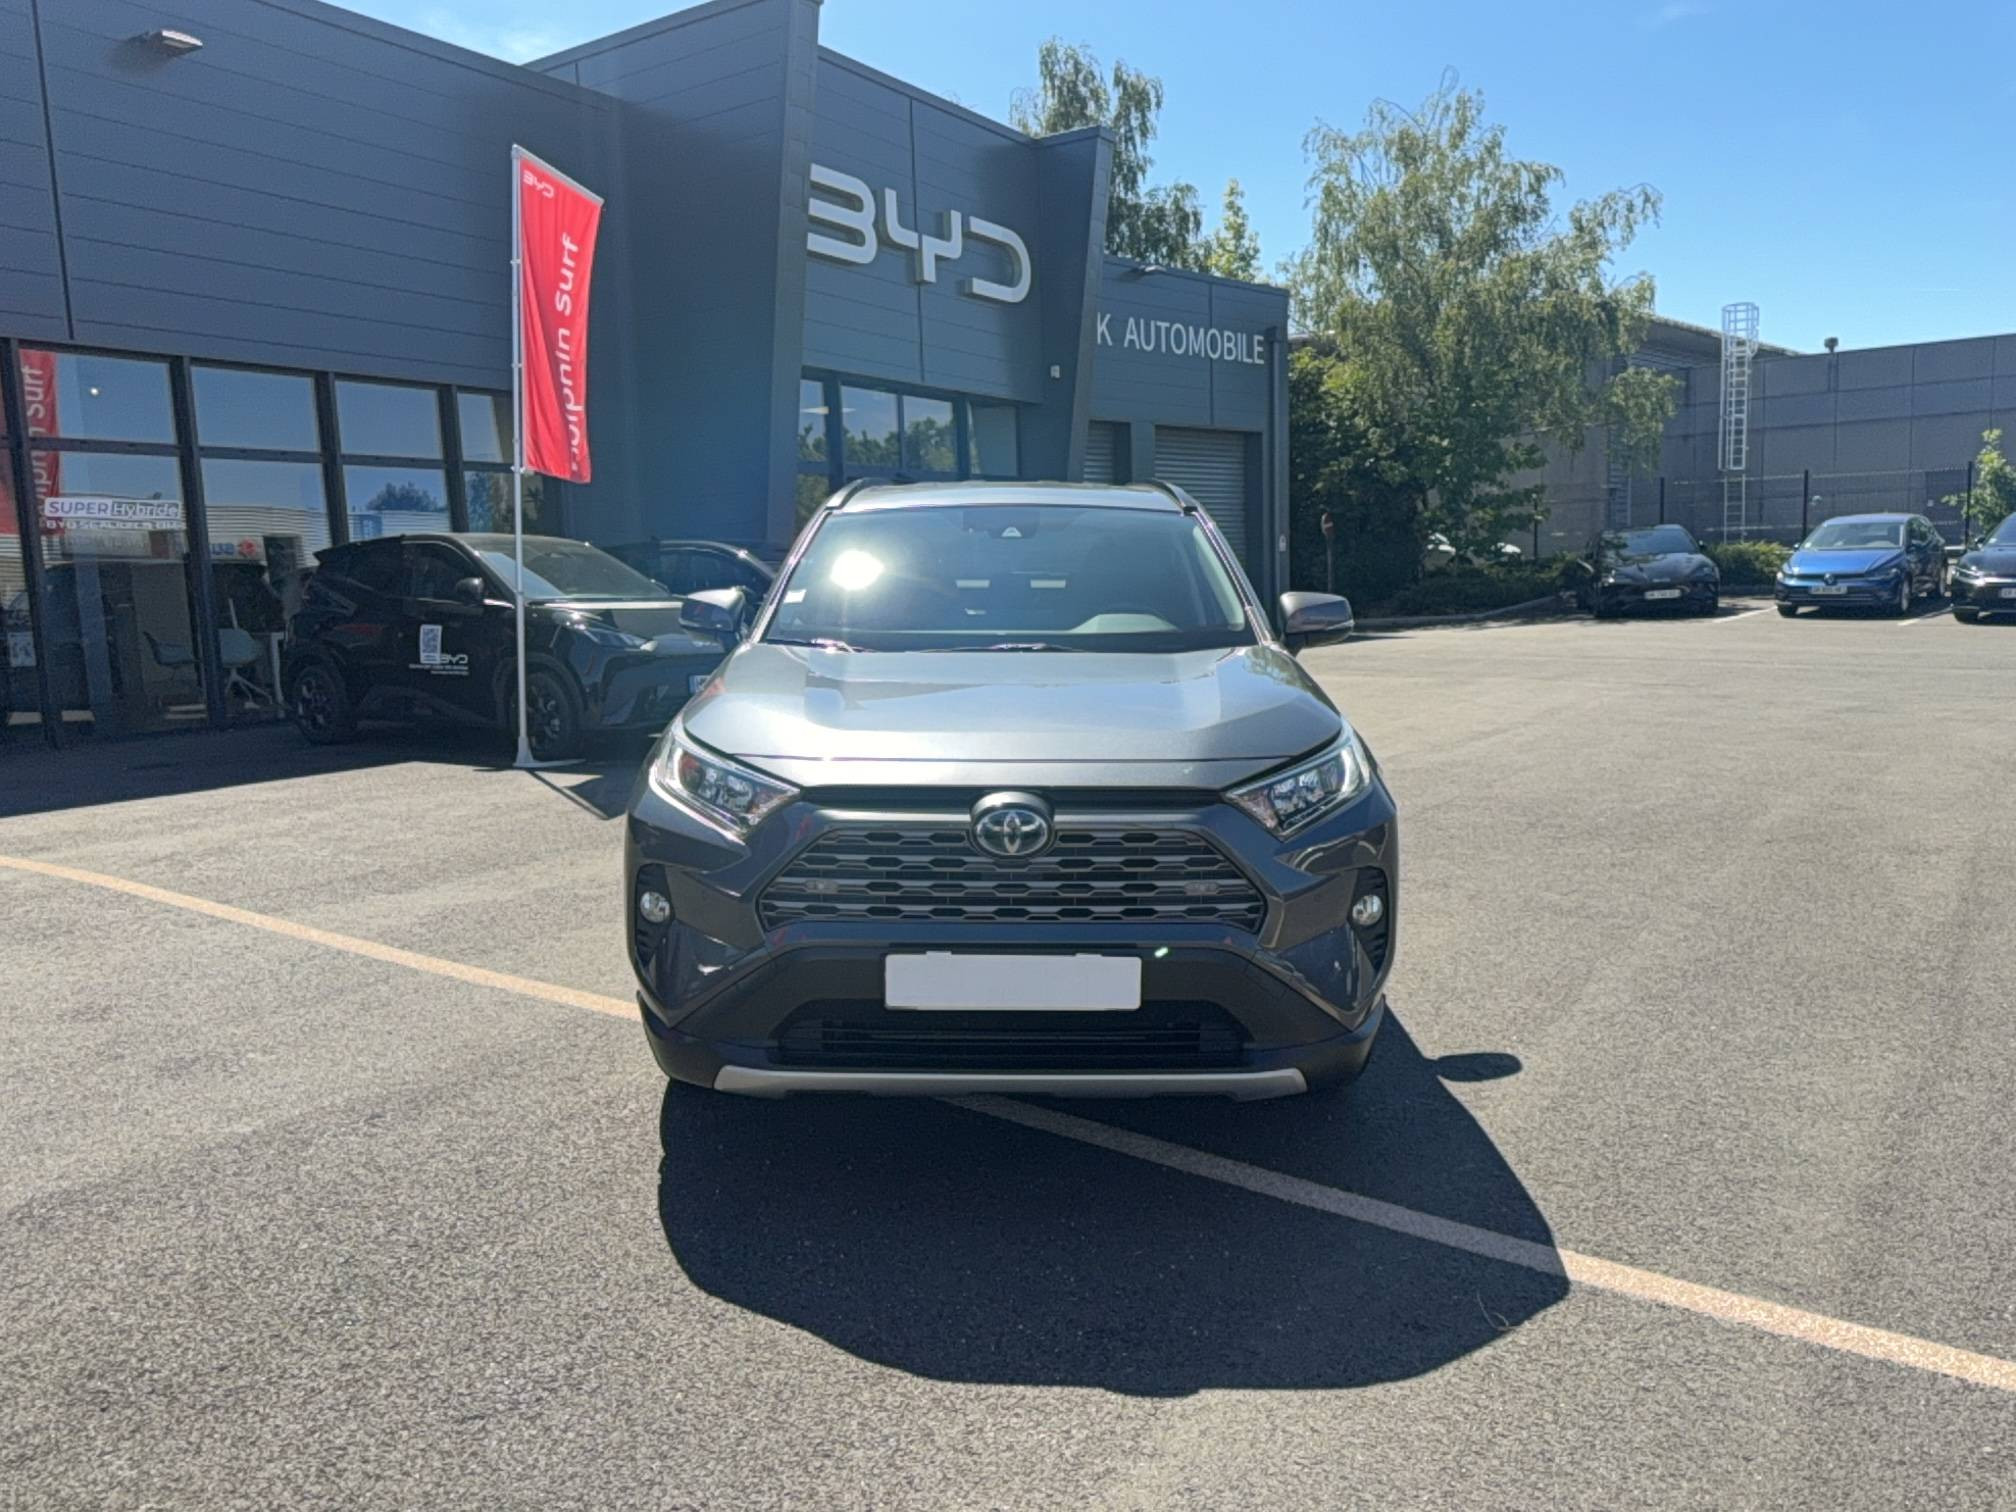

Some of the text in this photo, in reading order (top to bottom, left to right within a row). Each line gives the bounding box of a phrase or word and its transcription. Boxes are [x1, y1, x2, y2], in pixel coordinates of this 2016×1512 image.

[523, 169, 556, 200] BYD
[806, 162, 1034, 305] BYD
[554, 232, 580, 317] Surf
[1096, 311, 1266, 366] K AUTOMOBILE
[48, 501, 179, 519] SUPER Hybride
[440, 653, 469, 664] BYD
